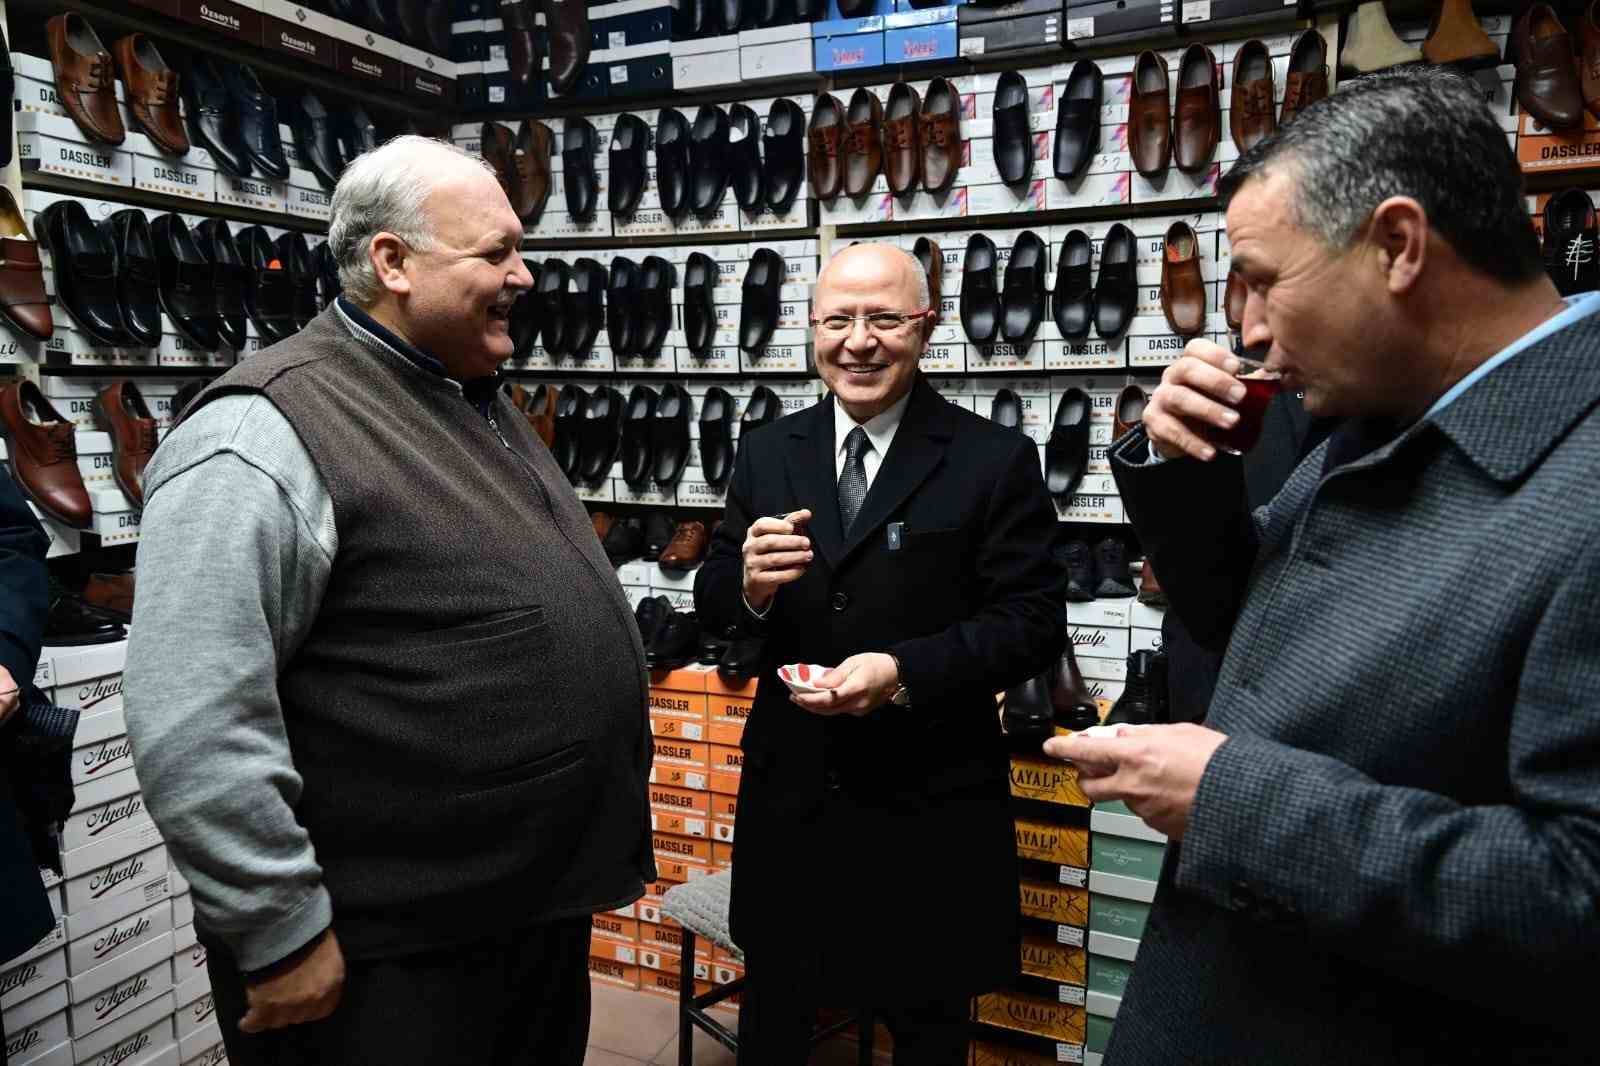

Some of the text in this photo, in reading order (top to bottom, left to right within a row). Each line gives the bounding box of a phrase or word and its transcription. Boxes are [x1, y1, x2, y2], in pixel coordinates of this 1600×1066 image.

[60, 148, 112, 168] DASSLER
[1542, 143, 1600, 159] DASSLER
[154, 167, 198, 185] DASSLER
[1063, 344, 1108, 356] DASSLER
[654, 745, 691, 759] ASSLER
[652, 791, 693, 808] DASSLER
[654, 839, 694, 856] DASSLER
[1023, 888, 1058, 909] YALP
